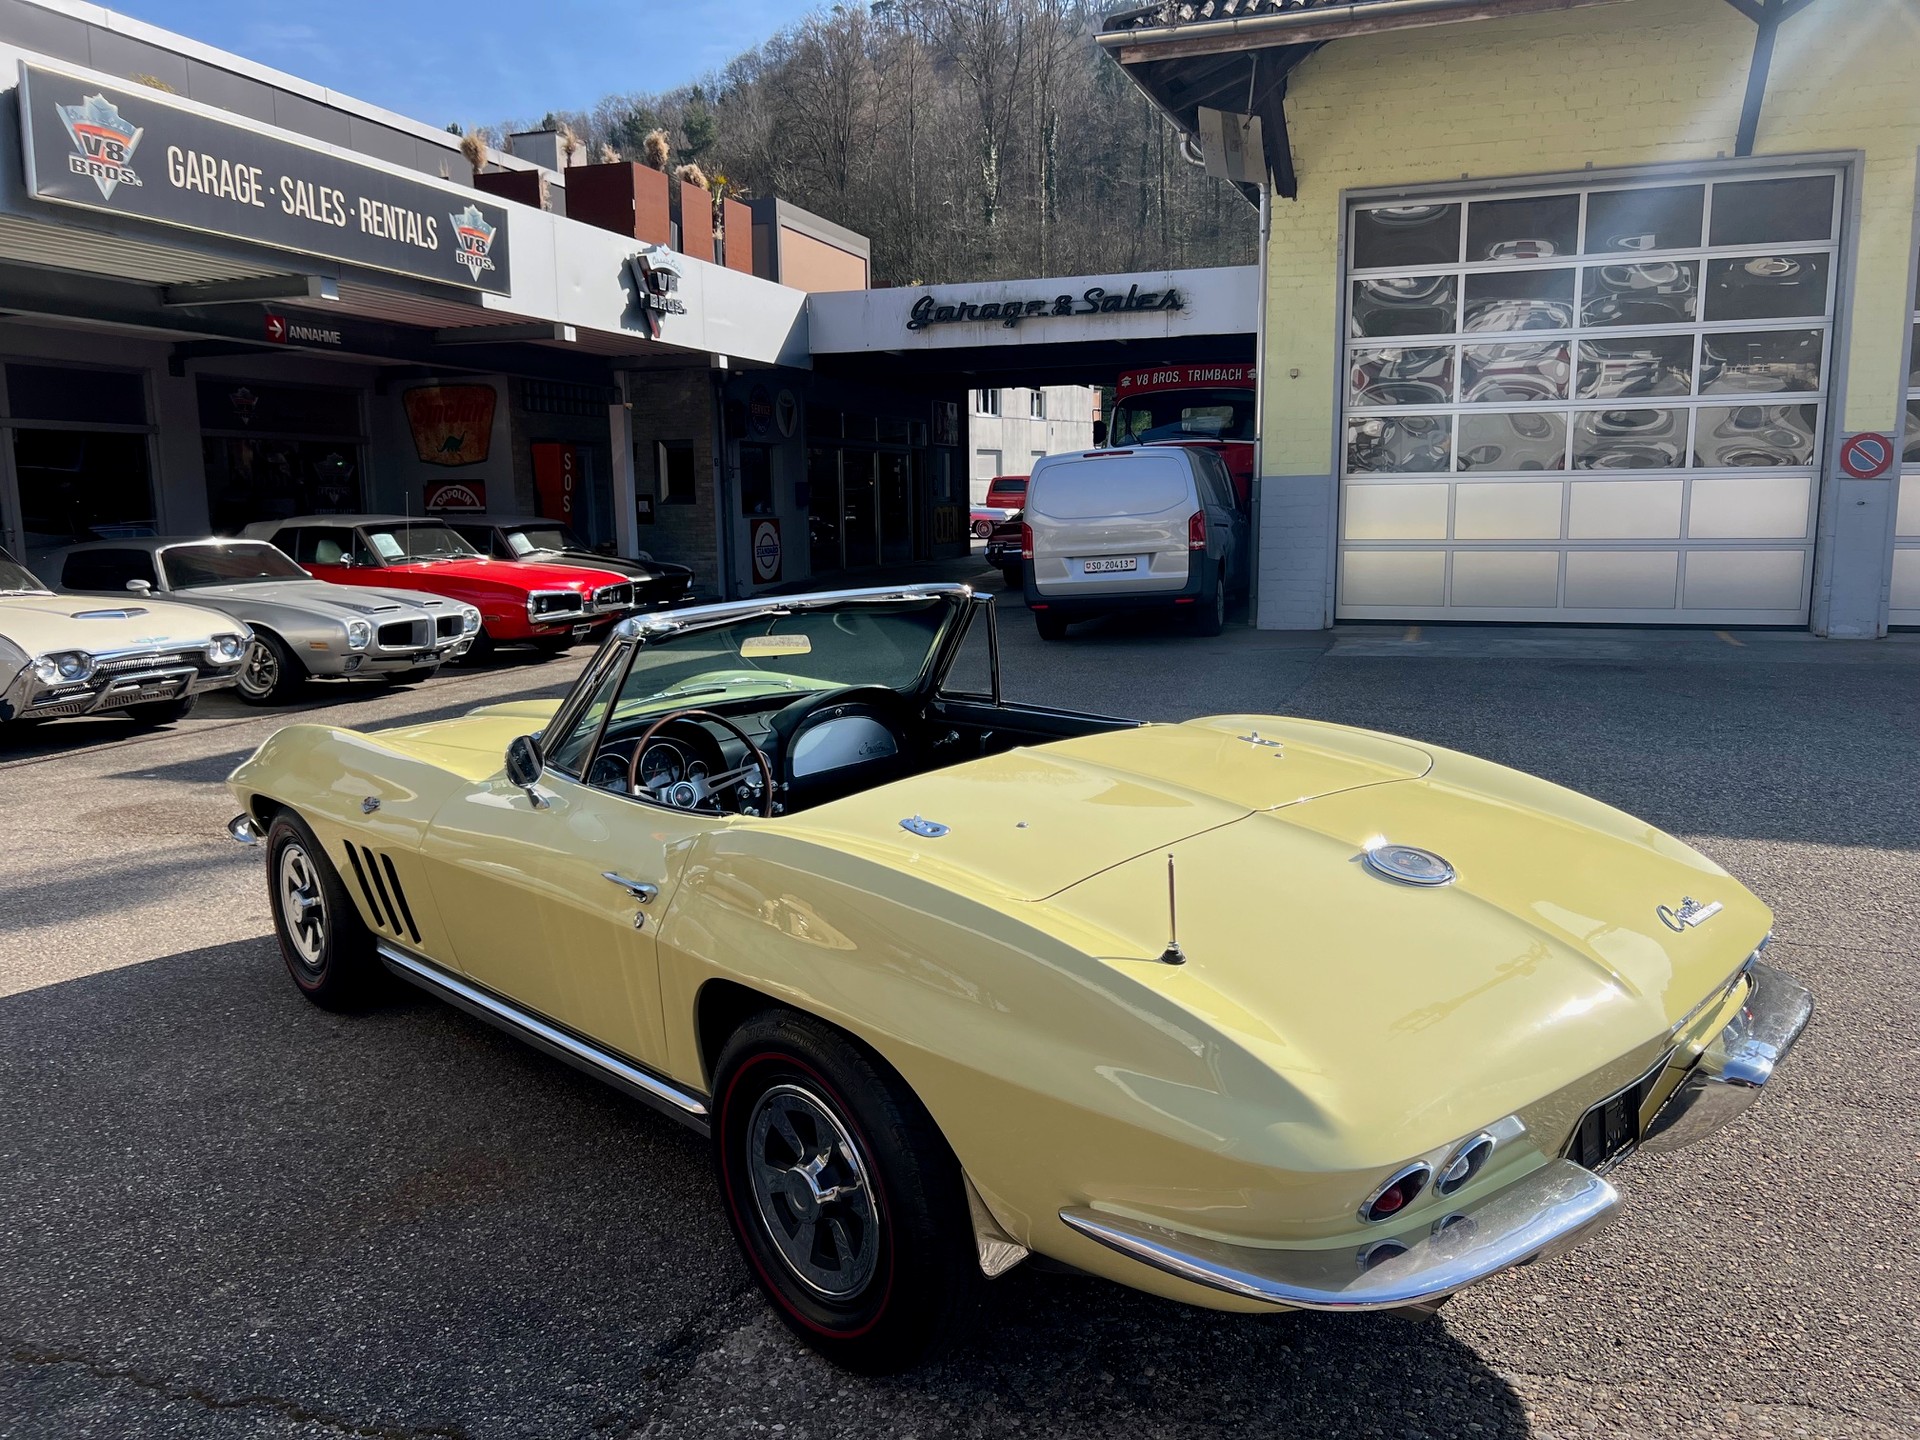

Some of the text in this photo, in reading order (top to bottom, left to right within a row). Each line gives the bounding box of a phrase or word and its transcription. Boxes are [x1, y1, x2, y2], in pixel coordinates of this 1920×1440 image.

[81, 132, 125, 162] V8
[70, 156, 142, 186] BROS.
[167, 145, 438, 251] GARAGE SALES RENTALS
[463, 234, 486, 255] V8
[456, 251, 495, 271] BROS.
[657, 272, 678, 291] V8
[650, 294, 687, 314] BROS.
[907, 283, 1184, 330] Garage & Sales
[289, 325, 341, 344] ANNAHME
[1136, 368, 1242, 386] V8 BROS. TRIMBACH
[413, 394, 489, 425] Sinclair
[563, 452, 572, 512] SOS
[436, 489, 473, 506] DAPOLIN
[756, 546, 779, 556] STANDARD
